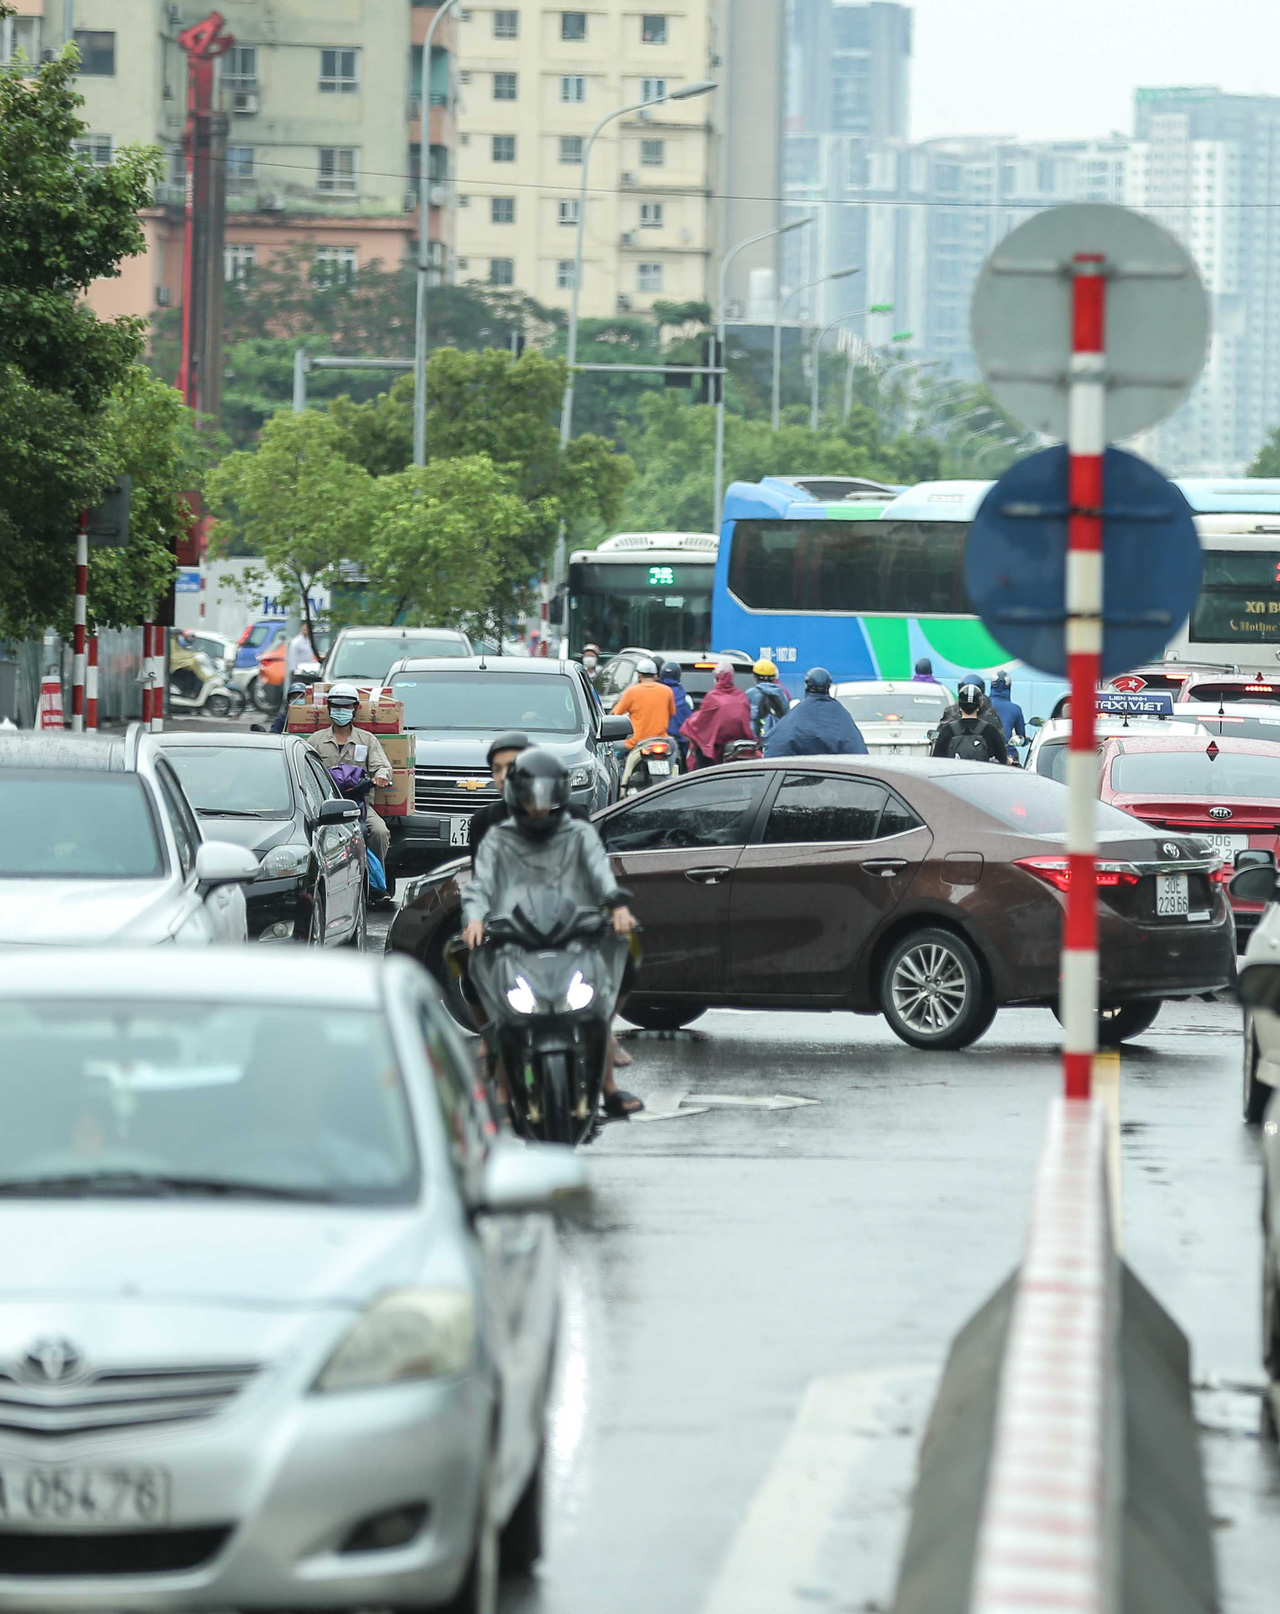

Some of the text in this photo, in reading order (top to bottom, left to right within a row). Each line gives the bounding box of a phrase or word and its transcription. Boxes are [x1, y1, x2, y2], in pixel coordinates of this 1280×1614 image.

[1207, 835, 1231, 847] 30G
[1165, 877, 1182, 894] 30E
[1158, 896, 1189, 914] 229.66
